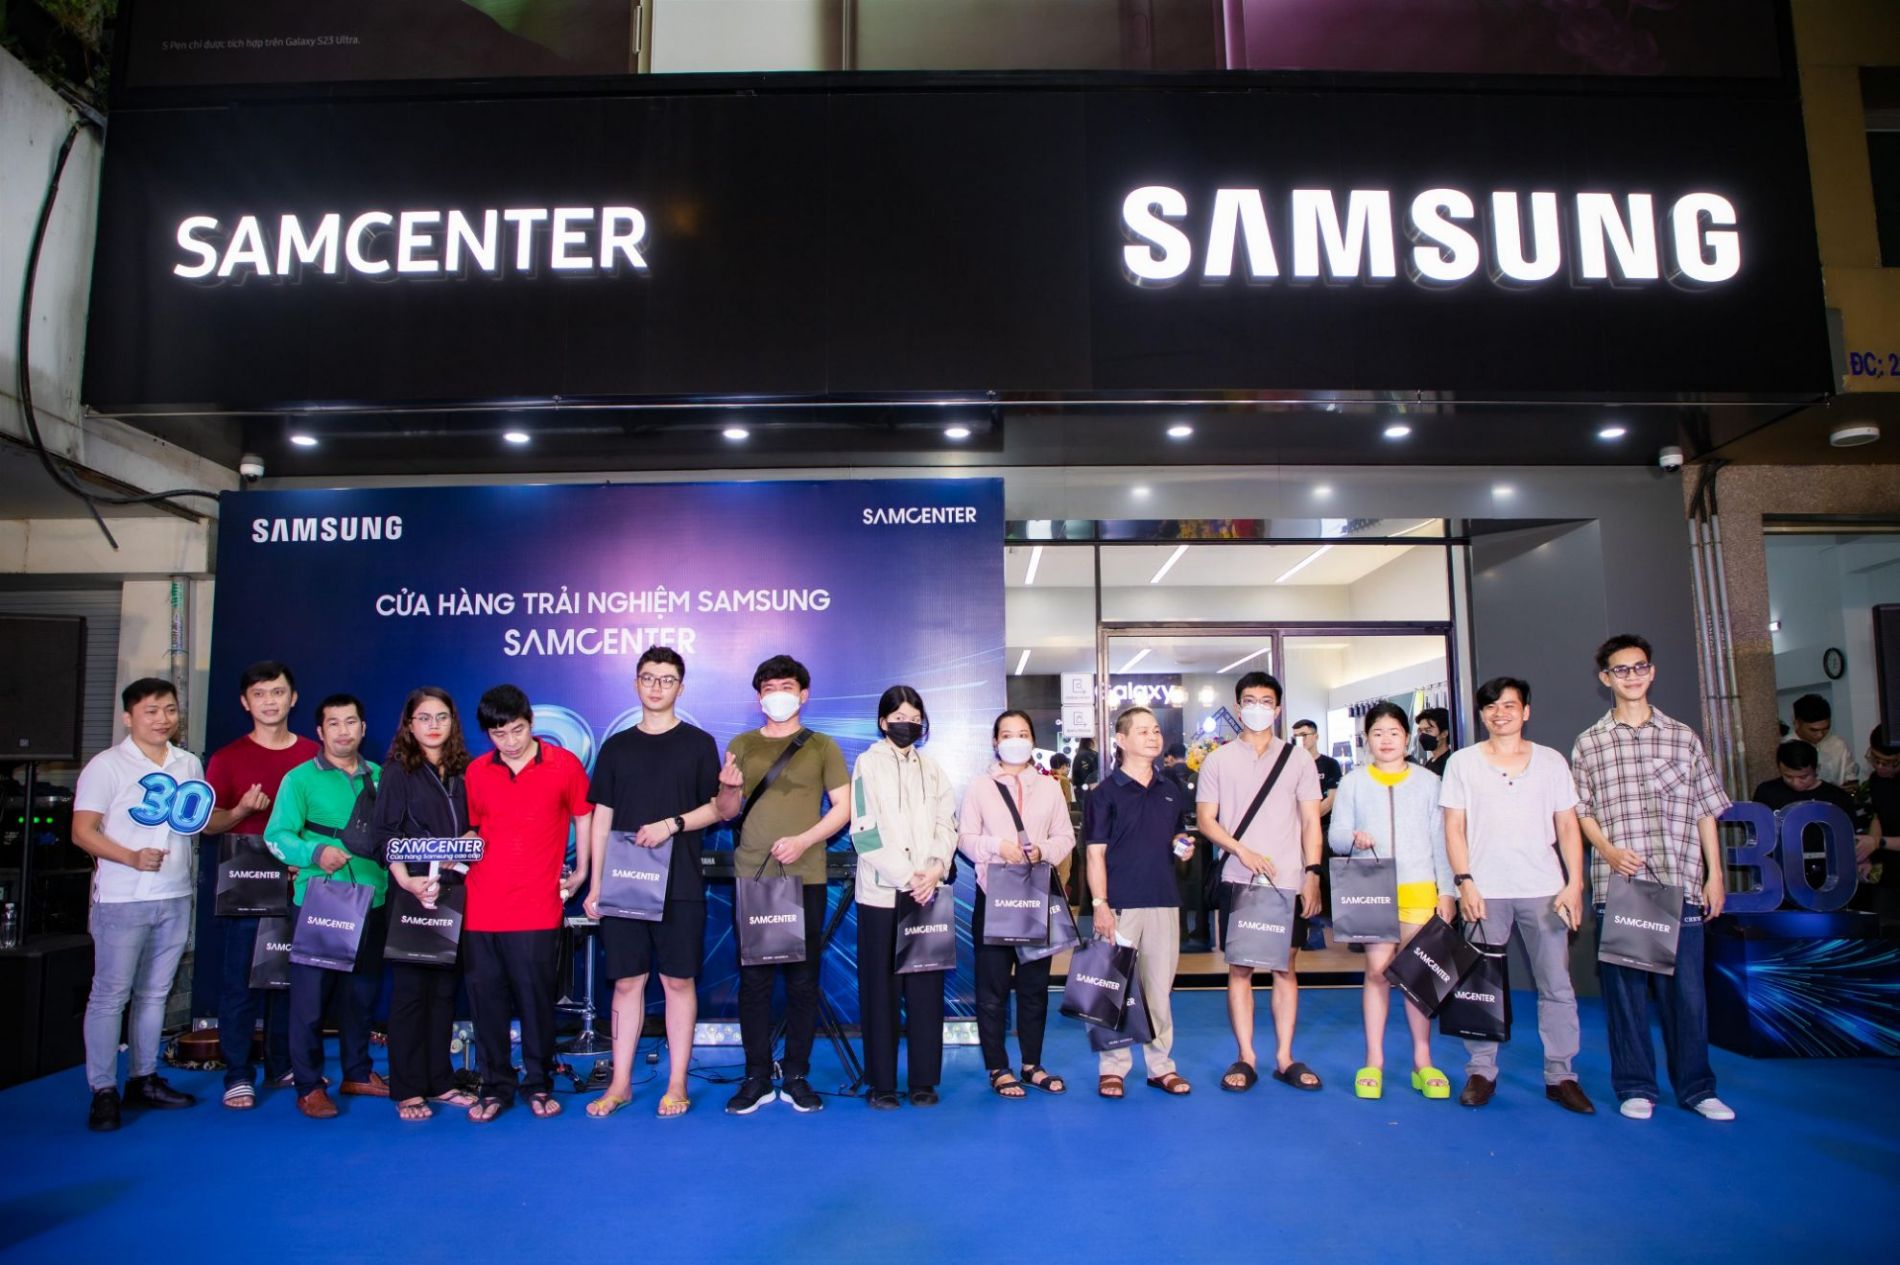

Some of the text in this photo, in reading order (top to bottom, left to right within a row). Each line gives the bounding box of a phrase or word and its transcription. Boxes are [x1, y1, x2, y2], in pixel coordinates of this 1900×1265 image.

[169, 41, 188, 50] Pen
[285, 37, 316, 47] Galaxy
[317, 36, 334, 45] S23
[1122, 185, 1741, 283] SAMSUNG
[173, 206, 649, 278] SAMCENTER
[863, 506, 977, 525] SAMCENTER
[251, 515, 403, 543] SAMSUNG
[375, 585, 831, 620] CỬA HÀNG TRẢI NGHIỆM SAMSUNG
[503, 627, 697, 656] SAMCENTER
[128, 772, 214, 833] 30
[390, 840, 483, 854] SAMCENTER
[228, 870, 281, 879] SAMCENTER
[612, 868, 660, 882] SAMCENTER
[994, 899, 1041, 908] SAMCENTER
[1340, 896, 1392, 904] SAMCENTER
[307, 915, 356, 930] SAMCENTER
[401, 915, 454, 927] SAMCENTER
[749, 914, 798, 925] SAMCENTER
[1237, 920, 1286, 934] SAMCENTER
[1614, 915, 1671, 933] SAMCENTER
[904, 923, 948, 936] SAMCENTER
[1413, 946, 1451, 983] SAMCENTER
[1076, 973, 1120, 991] SAMCENTER
